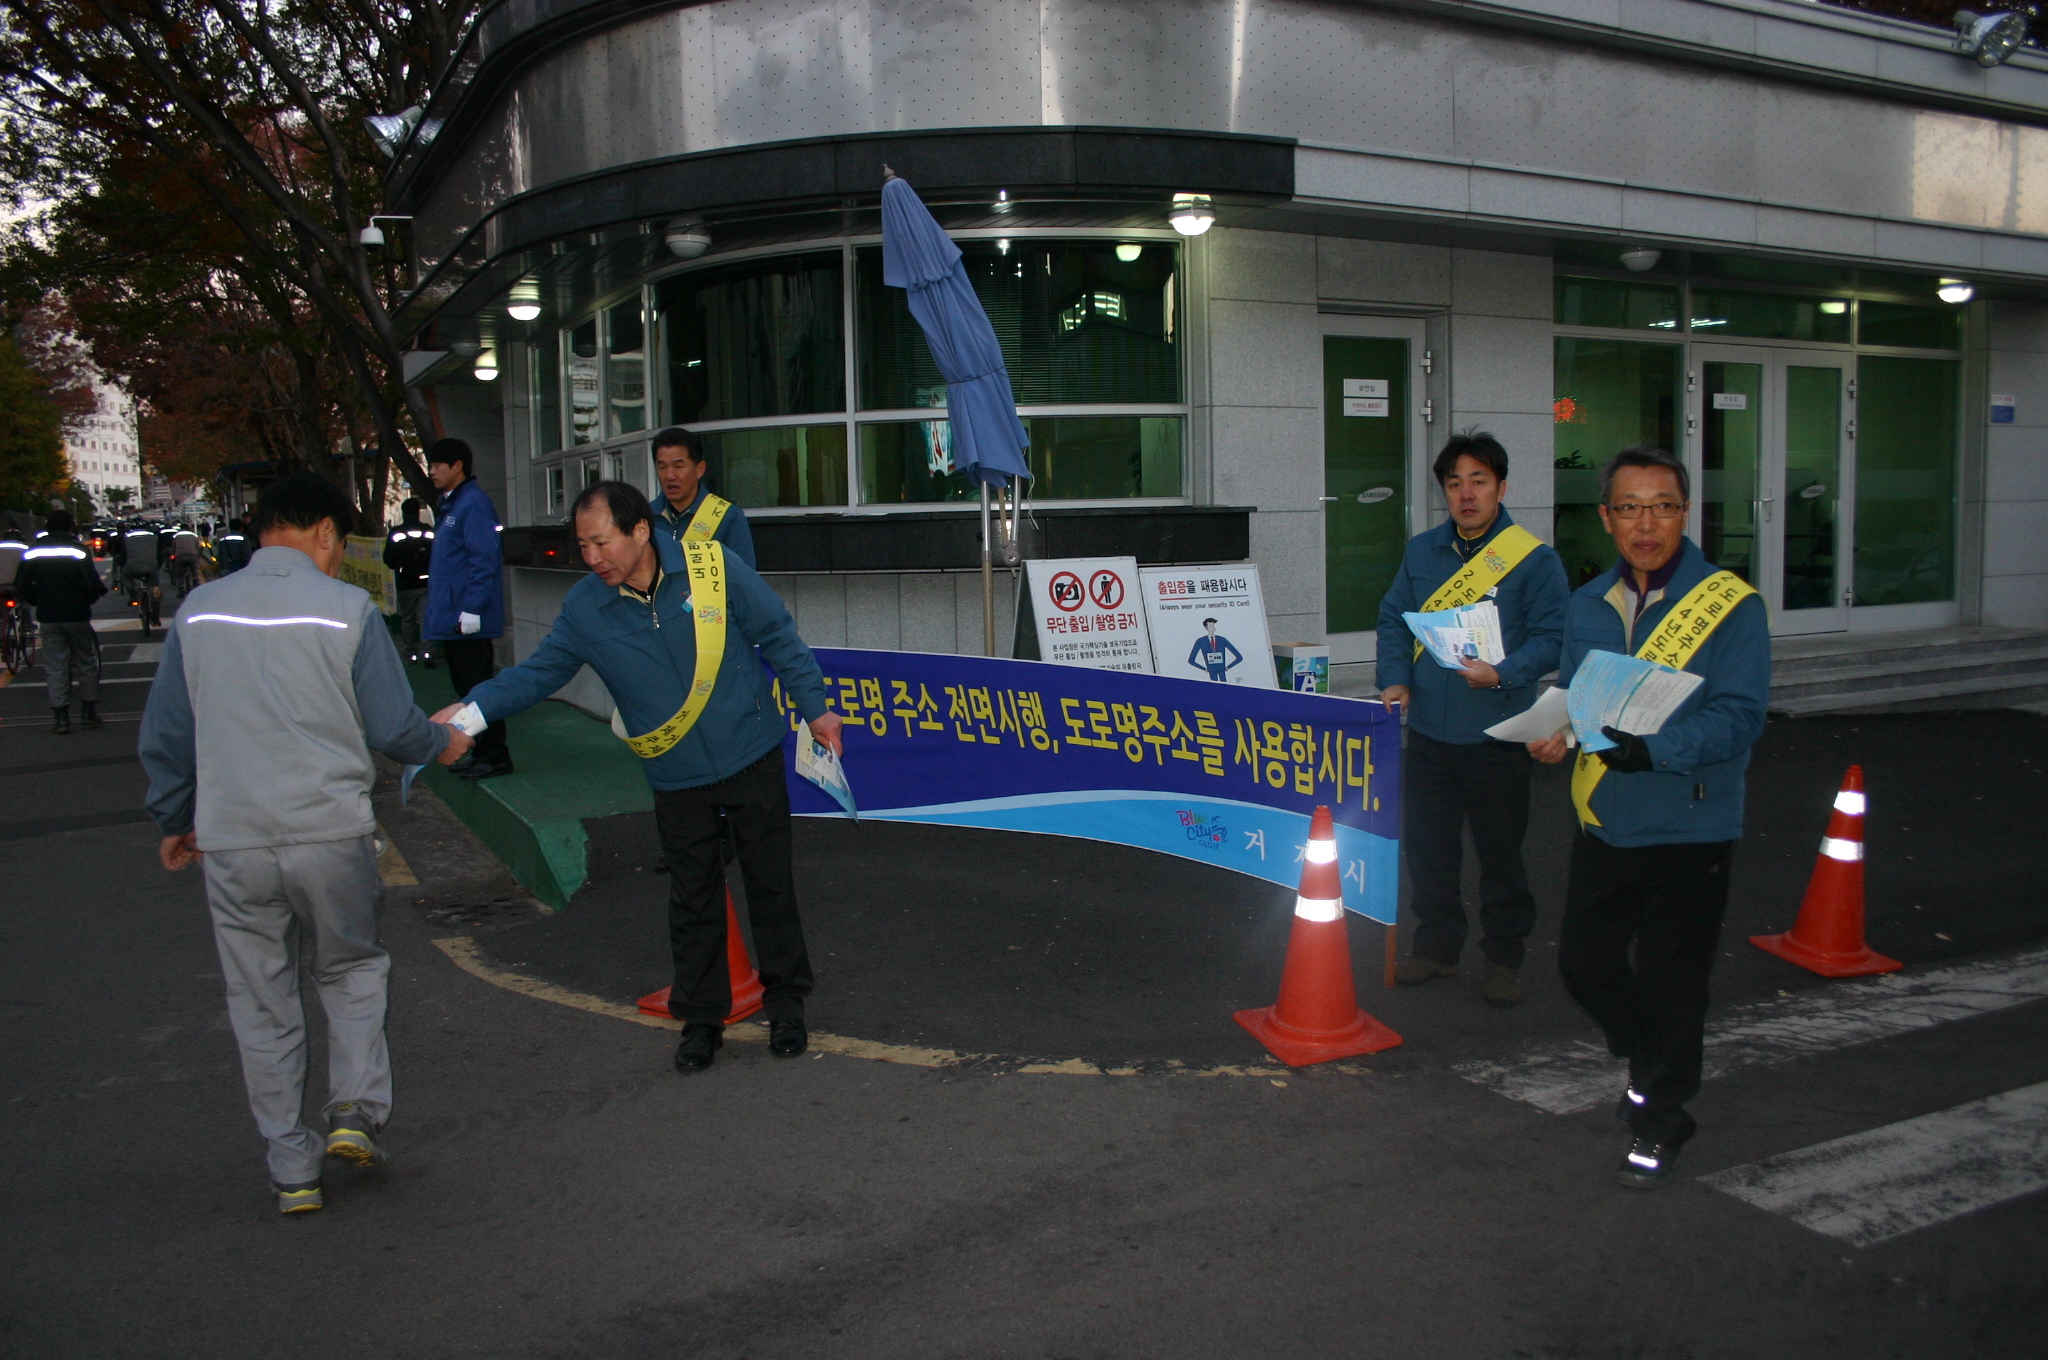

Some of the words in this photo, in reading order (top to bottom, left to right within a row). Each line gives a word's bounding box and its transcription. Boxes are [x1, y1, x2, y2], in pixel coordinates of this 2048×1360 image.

[1361, 491, 1389, 499] SAMSUNG
[1157, 579, 1196, 595] 출입증을
[1200, 577, 1247, 593] 패용합시다
[1195, 602, 1206, 610] your
[1208, 600, 1228, 609] security
[1444, 587, 1476, 610] 도로
[1046, 616, 1067, 634] 무단
[1068, 615, 1090, 633] 출입
[1095, 613, 1116, 631] 촬영
[1117, 612, 1138, 630] 금지
[1059, 642, 1079, 651] 사업장은
[1079, 640, 1108, 650] 국가핵심기술
[1109, 639, 1138, 648] 보유기업으로
[1054, 653, 1064, 661] 무단
[944, 683, 1060, 754] 전면시행,
[1059, 696, 1226, 777] 도로명주소를
[1233, 717, 1380, 812] 사용합시다.
[1186, 824, 1212, 842] City
